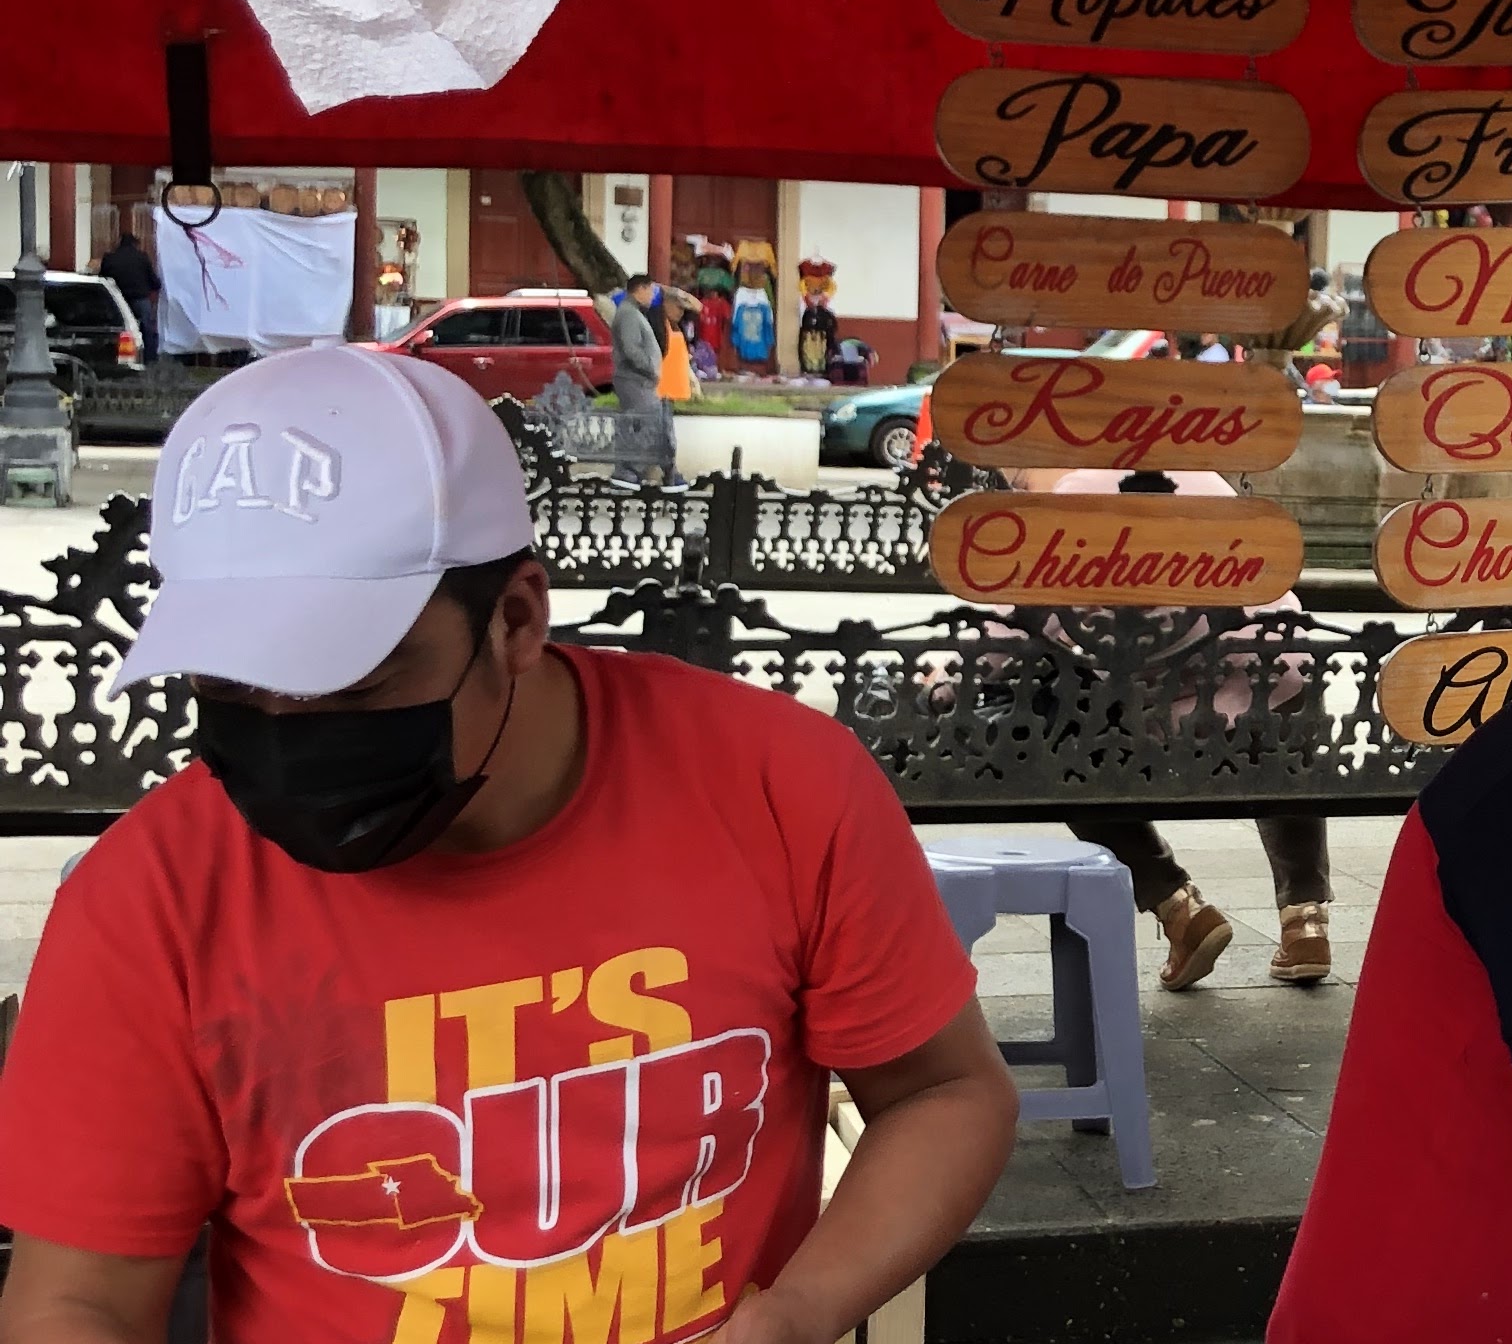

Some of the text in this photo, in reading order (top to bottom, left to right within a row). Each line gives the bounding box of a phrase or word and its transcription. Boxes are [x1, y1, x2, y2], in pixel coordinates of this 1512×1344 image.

[975, 73, 1260, 191] Papa
[971, 226, 1277, 304] Carne de Puerco
[963, 357, 1263, 469] Rajas
[957, 509, 1266, 593] Chicharrón
[284, 1027, 772, 1284] OUR
